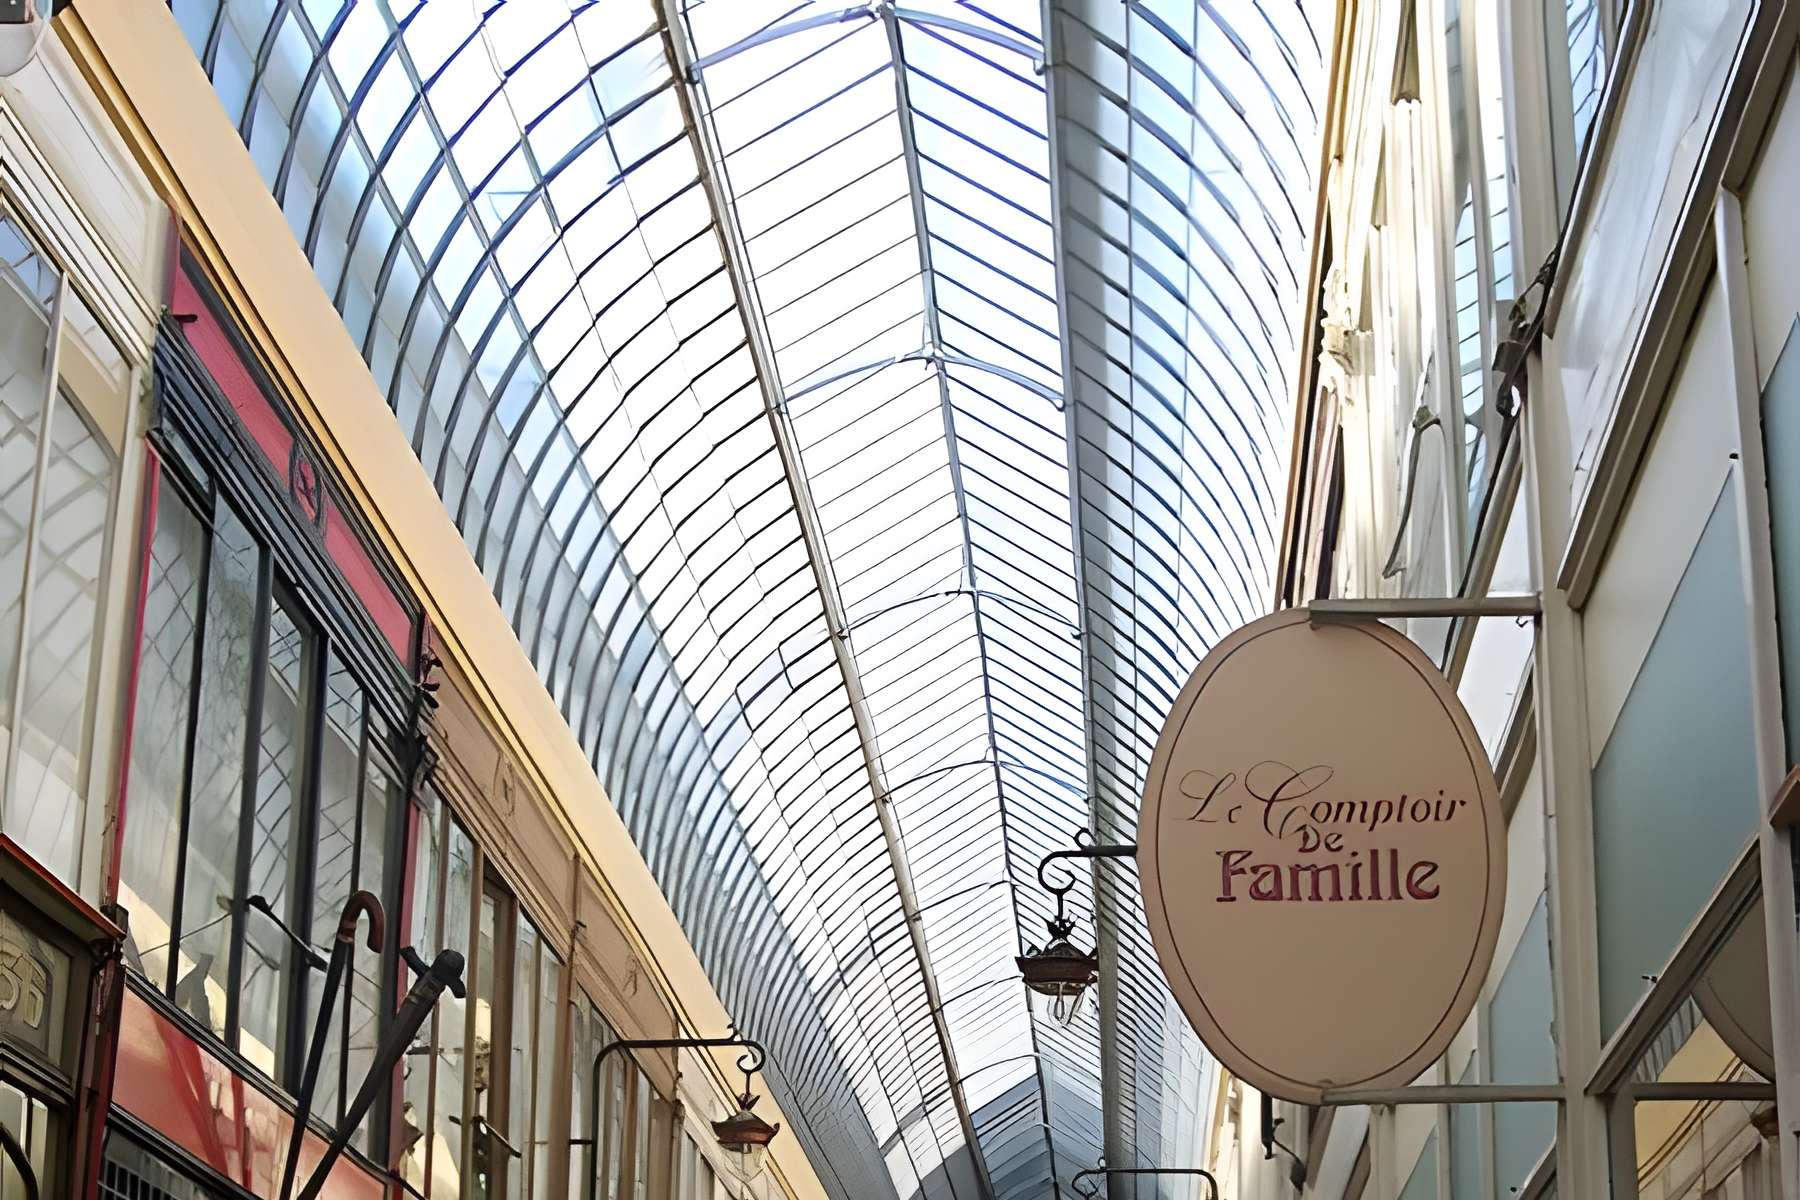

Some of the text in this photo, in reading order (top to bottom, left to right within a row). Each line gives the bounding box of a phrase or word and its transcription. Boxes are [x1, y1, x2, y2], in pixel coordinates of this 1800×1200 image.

[1172, 760, 1467, 839] Le Comptoir
[1216, 848, 1440, 902] Famille
